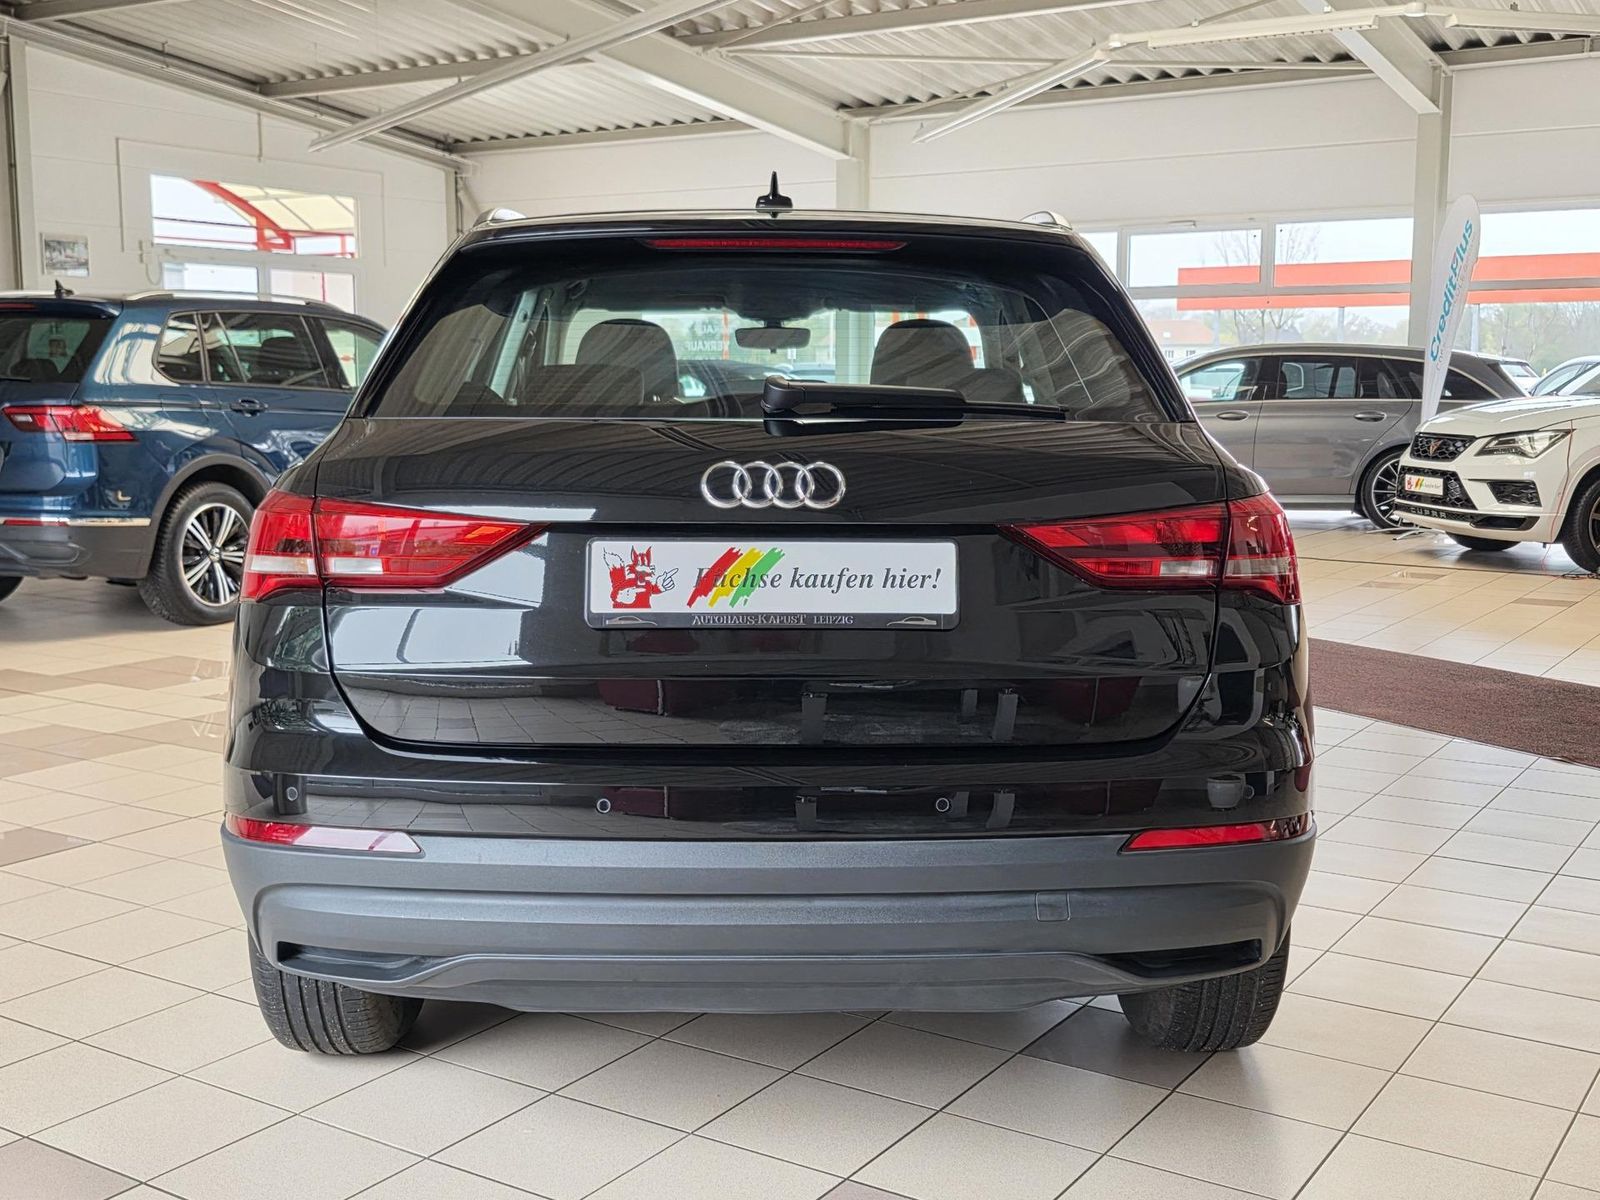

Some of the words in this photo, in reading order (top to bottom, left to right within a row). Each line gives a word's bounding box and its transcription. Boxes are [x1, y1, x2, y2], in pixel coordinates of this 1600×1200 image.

[1430, 220, 1473, 362] CreditPlus
[790, 567, 873, 594] kaufen
[882, 567, 941, 588] hier!
